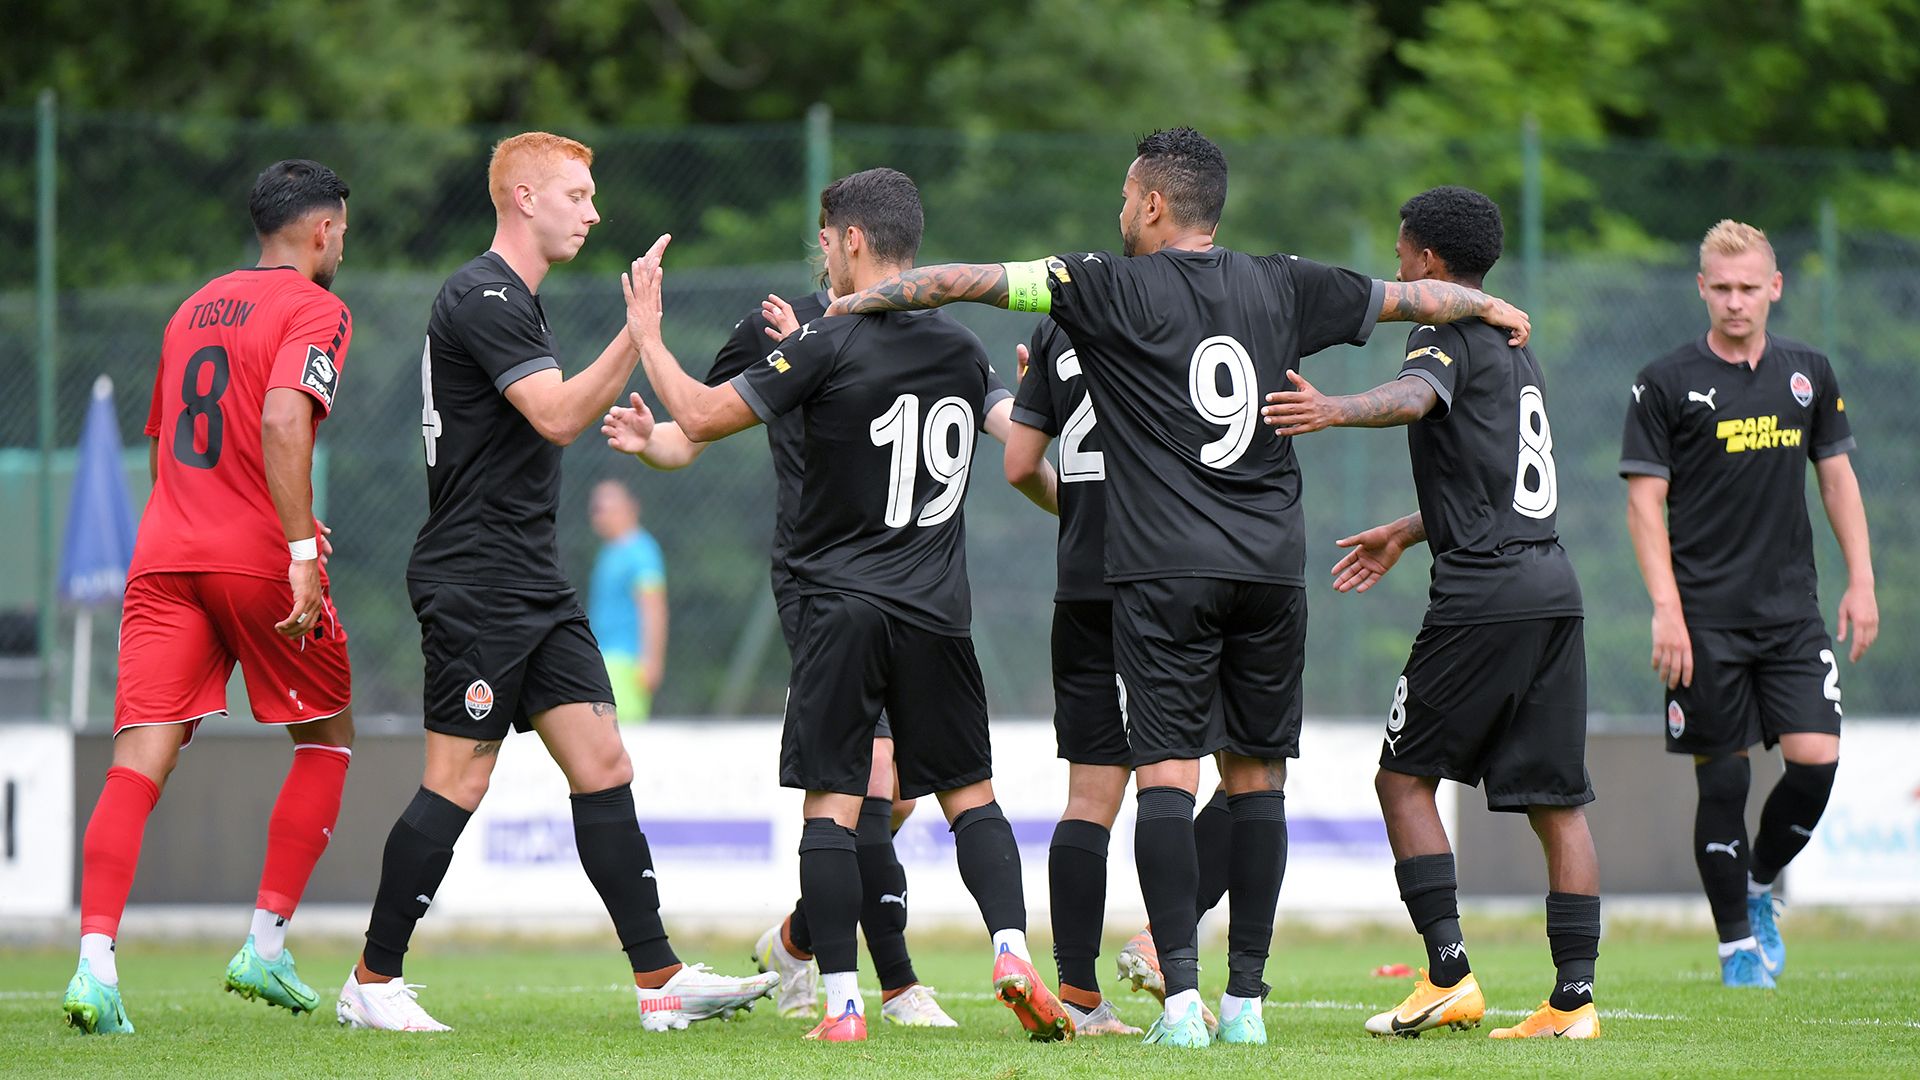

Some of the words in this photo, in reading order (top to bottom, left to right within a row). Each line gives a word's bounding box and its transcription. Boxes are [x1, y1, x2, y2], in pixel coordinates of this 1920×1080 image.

[188, 298, 256, 330] TOSUN
[172, 345, 231, 470] 8
[869, 394, 975, 528] 19
[1056, 348, 1106, 483] 2
[1188, 335, 1259, 469] 9
[1512, 385, 1558, 519] 8
[1716, 414, 1778, 440] PARI
[1726, 428, 1802, 453] MATCH
[1388, 675, 1409, 732] 8
